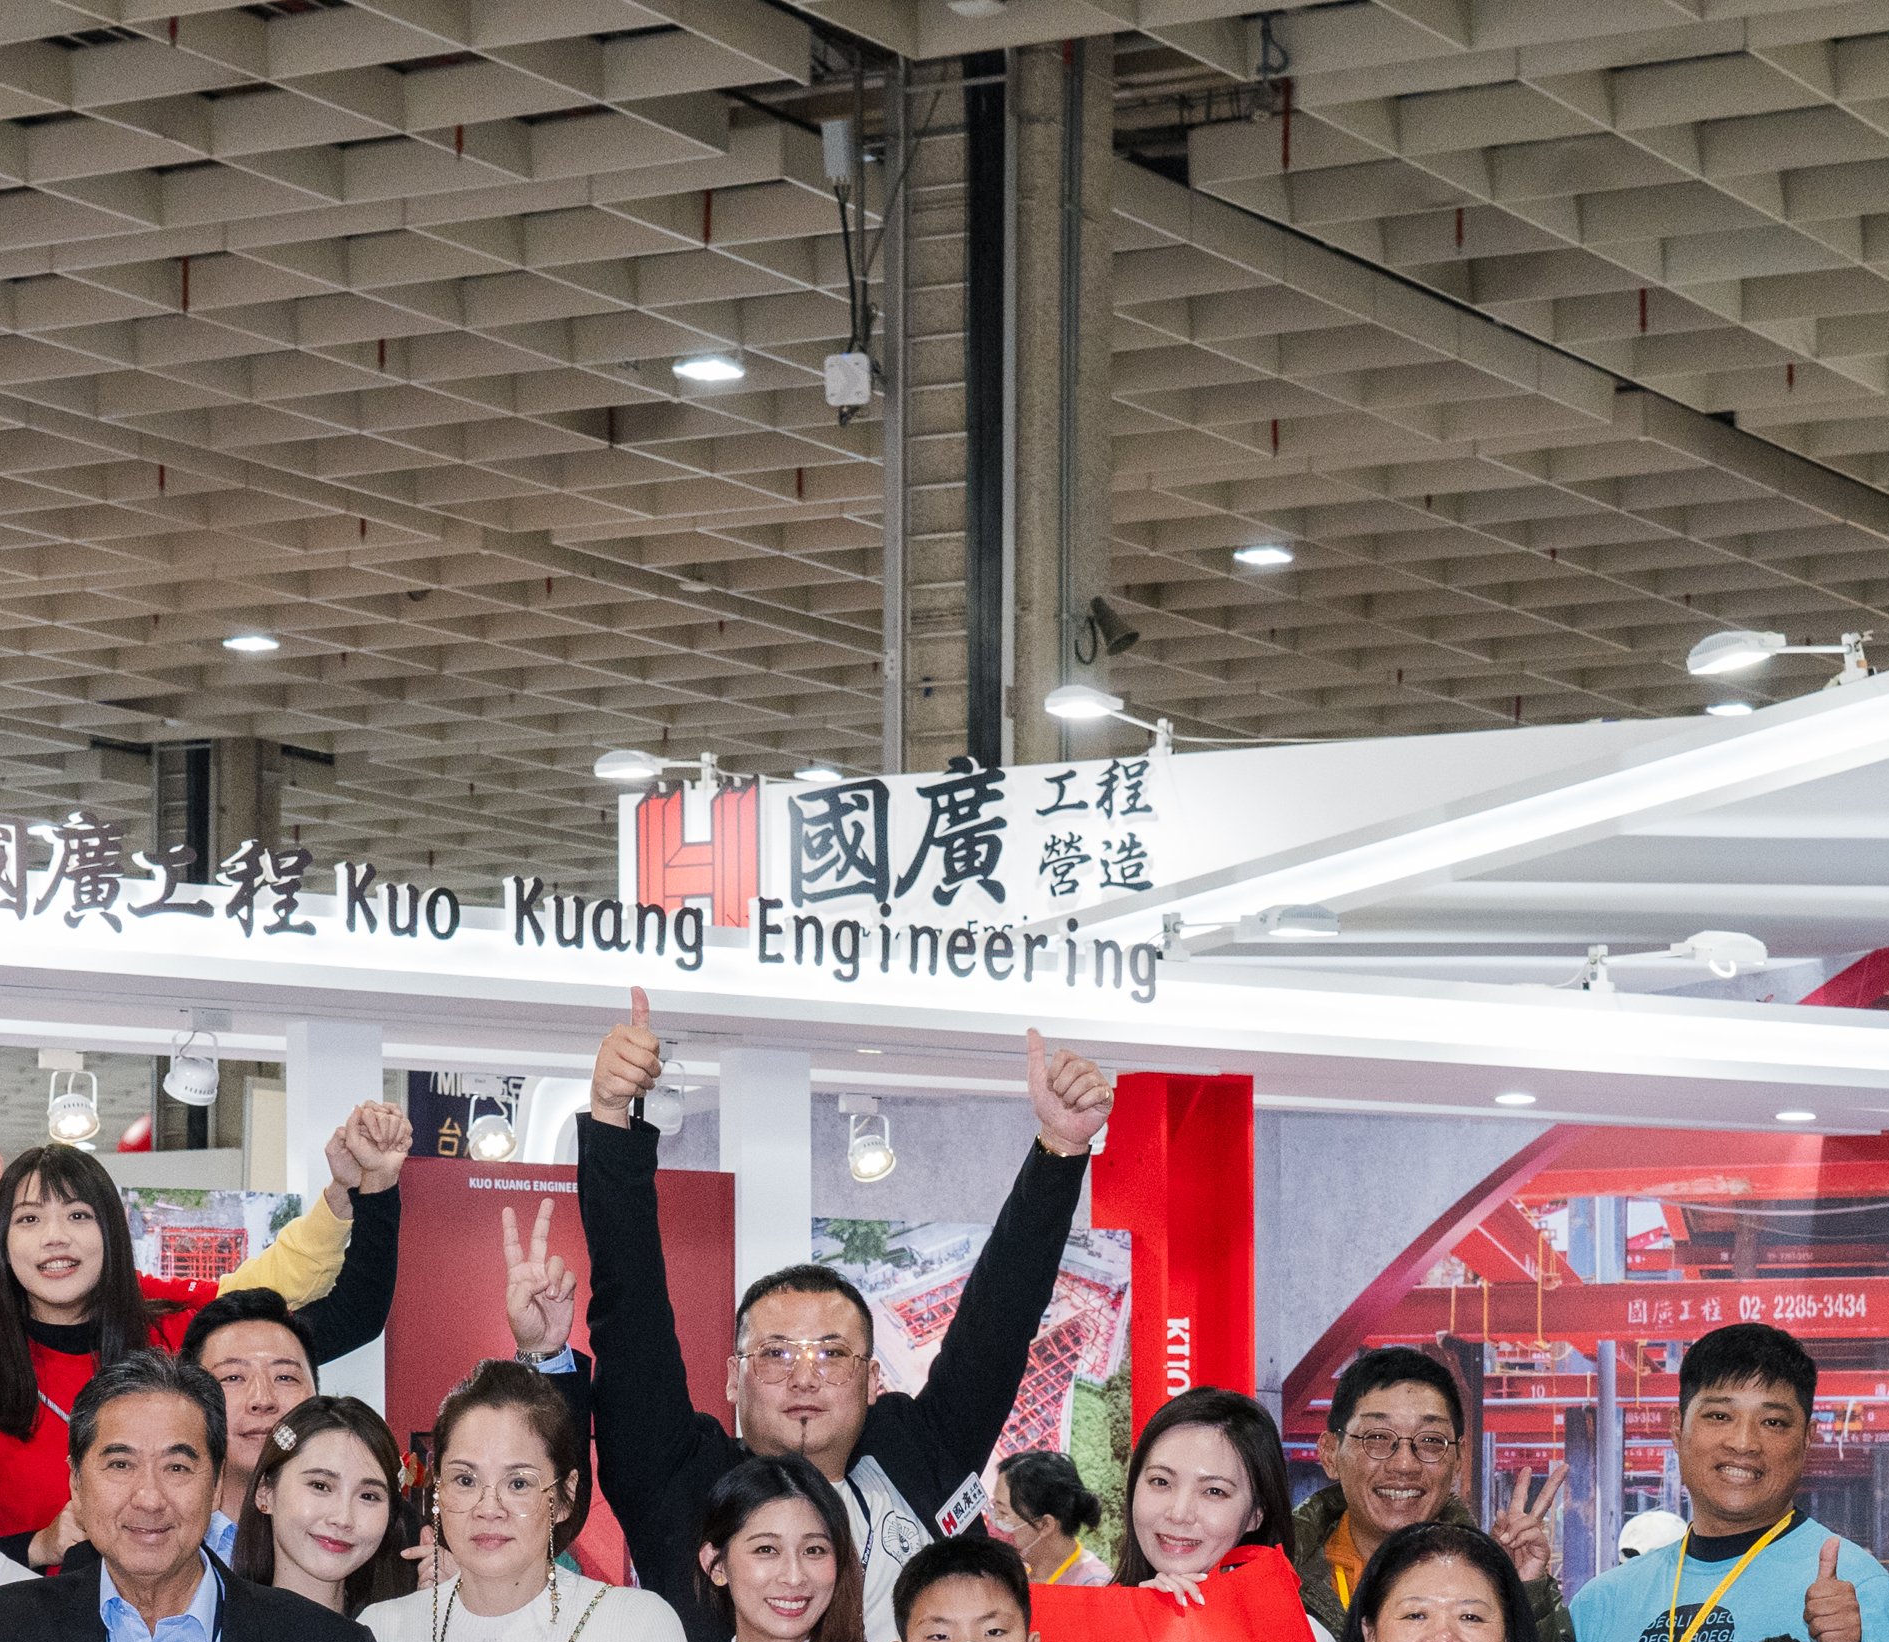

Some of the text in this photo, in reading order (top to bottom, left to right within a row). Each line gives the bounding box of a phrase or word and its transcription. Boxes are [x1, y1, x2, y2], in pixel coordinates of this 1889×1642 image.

[789, 756, 1007, 907] 國廣
[1036, 759, 1155, 820] 工程
[1038, 831, 1155, 897] 營造
[345, 862, 461, 941] Kuo
[512, 876, 704, 972] Kuang
[756, 896, 1158, 1004] Engineering
[469, 1177, 493, 1190] KUO
[494, 1178, 531, 1192] KUANG
